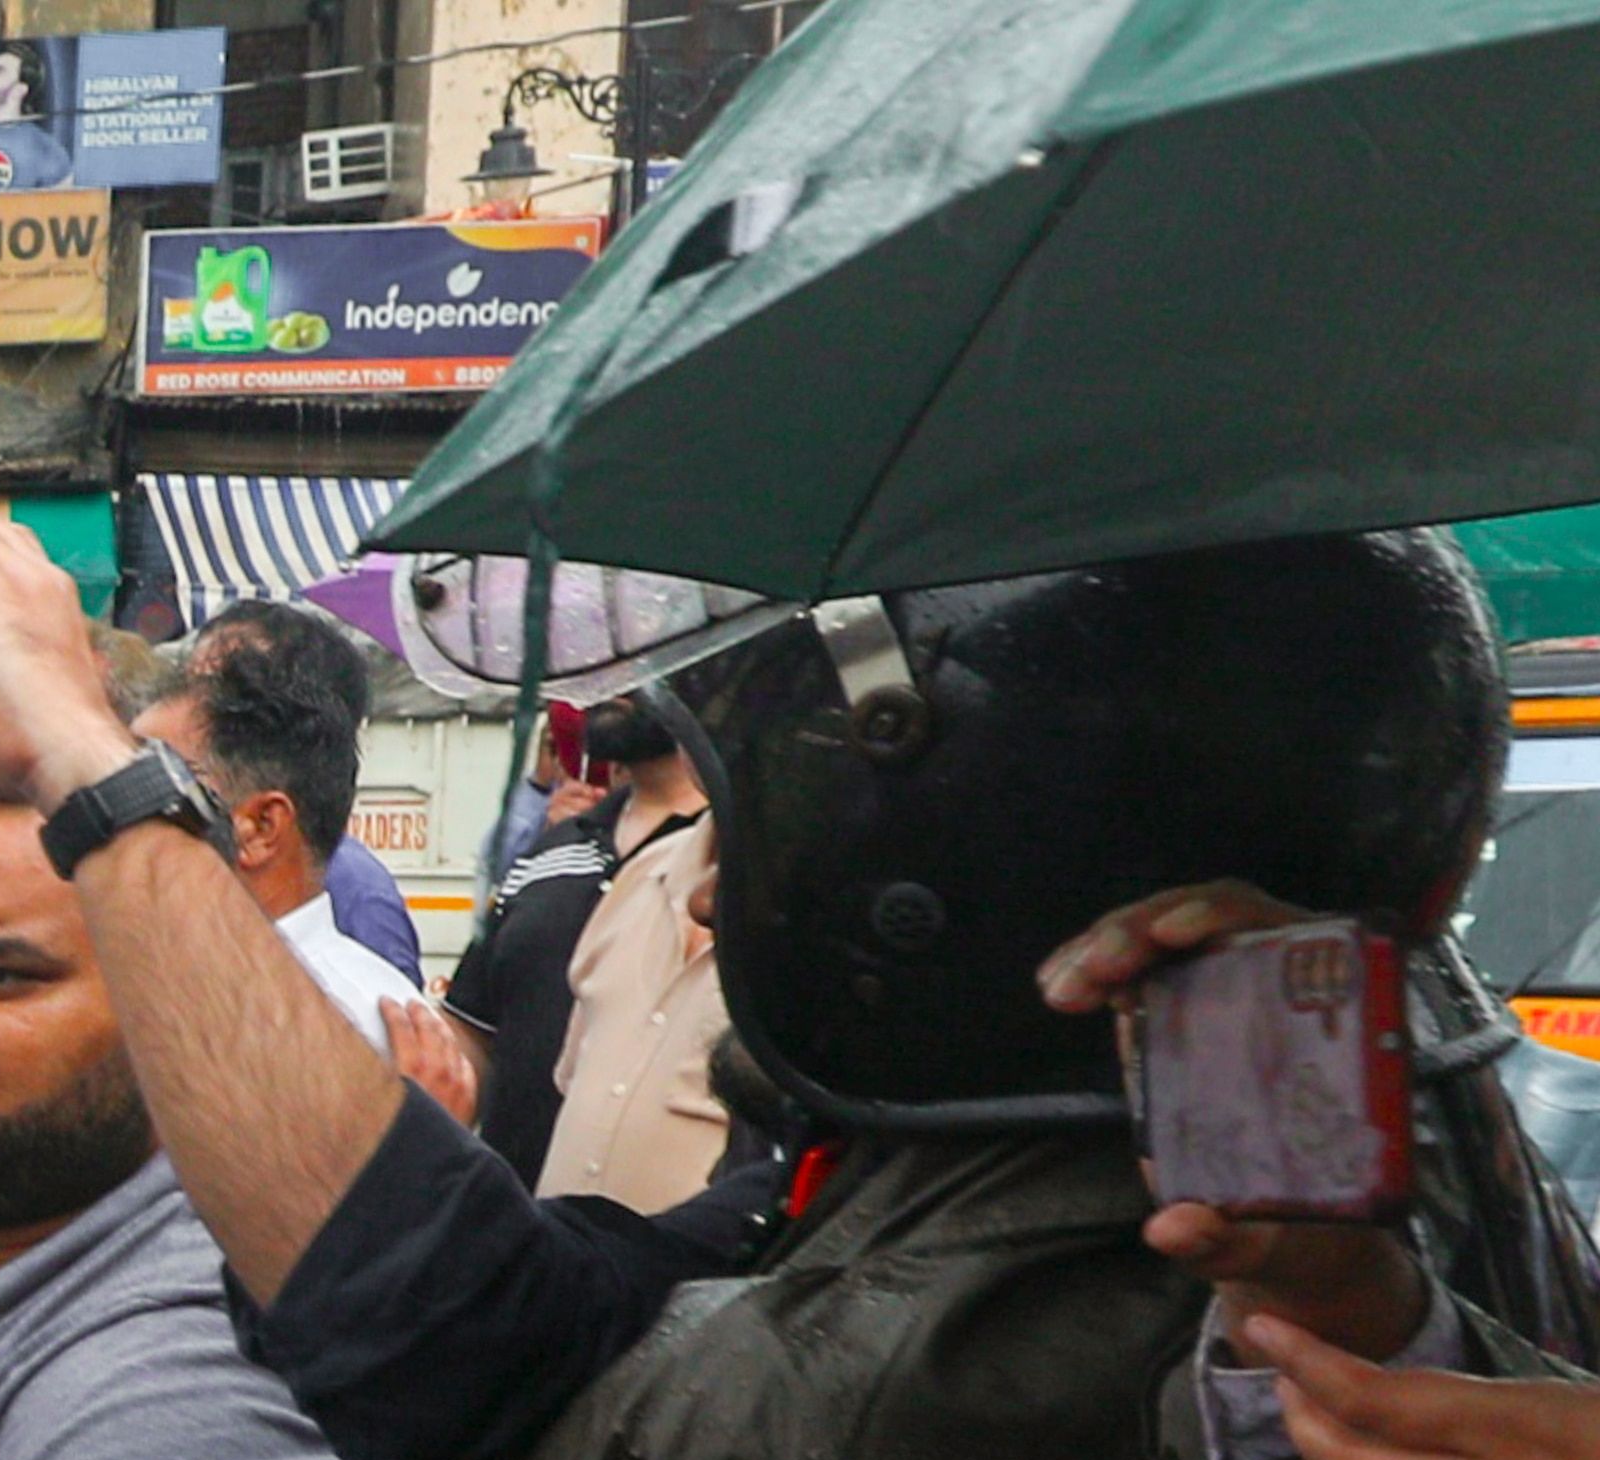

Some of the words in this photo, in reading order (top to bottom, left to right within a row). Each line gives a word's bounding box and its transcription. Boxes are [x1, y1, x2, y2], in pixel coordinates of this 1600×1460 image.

[81, 131, 136, 148] BOOK
[138, 127, 209, 144] SELLER
[156, 374, 191, 391] RED
[194, 371, 241, 389] ROSE
[243, 368, 407, 388] COMMUNICATION
